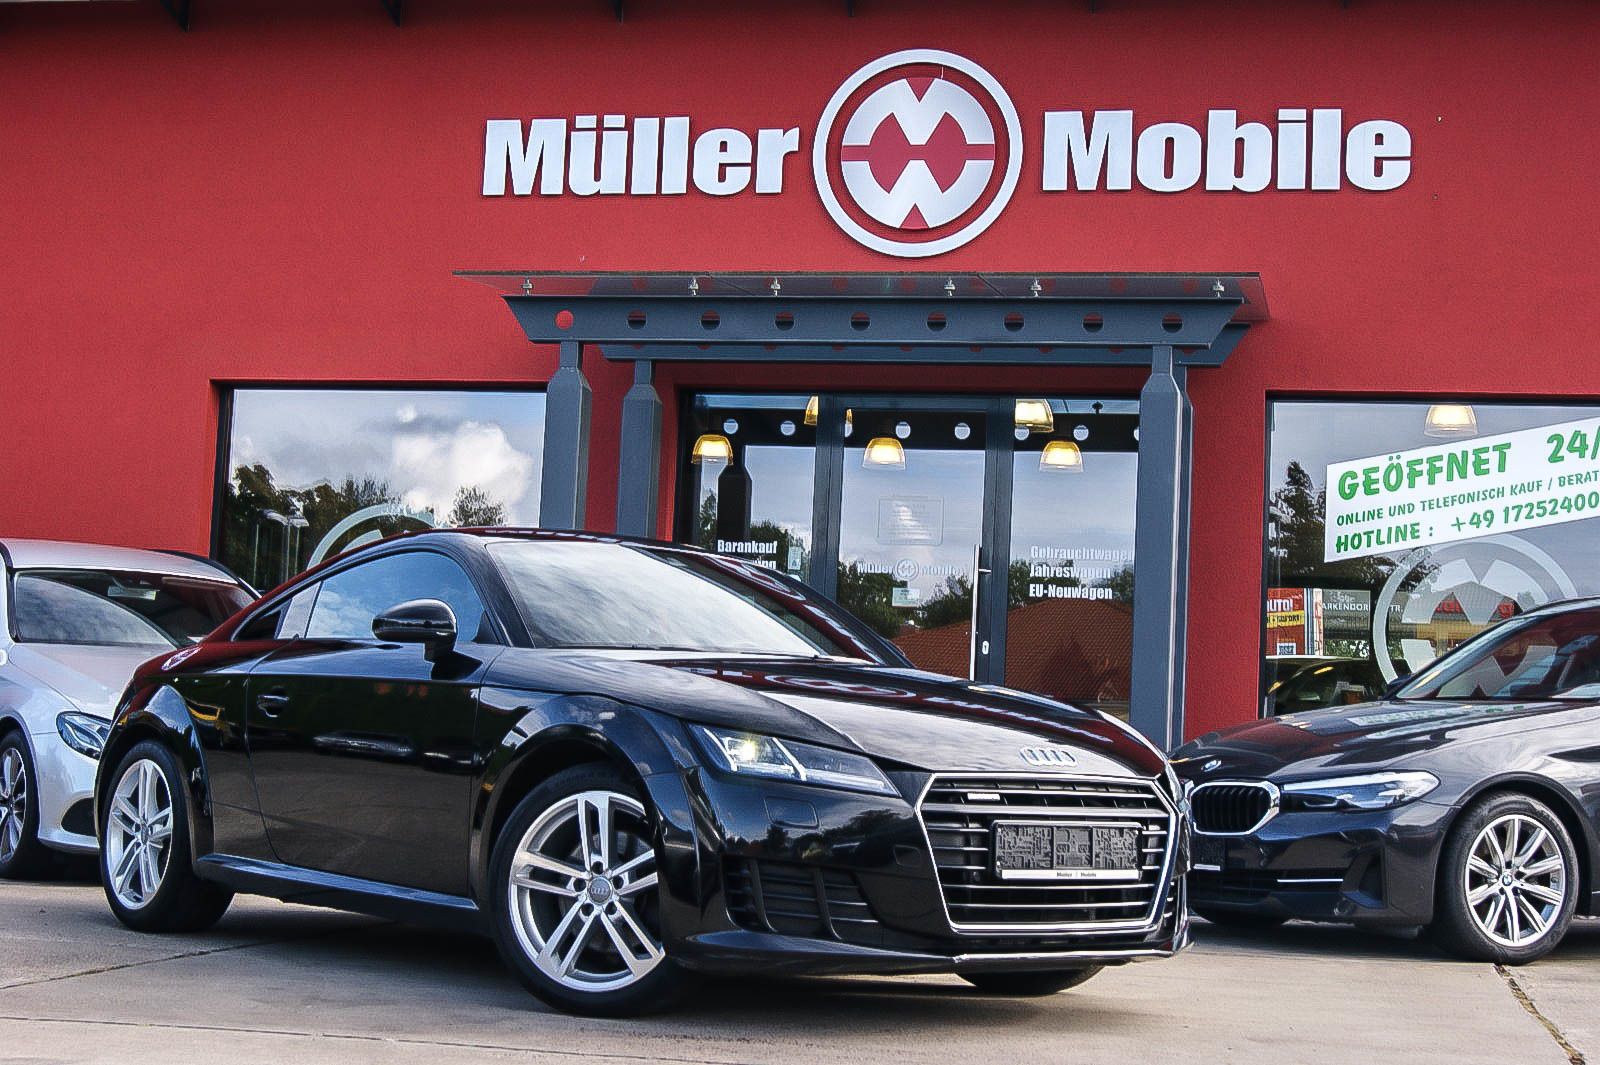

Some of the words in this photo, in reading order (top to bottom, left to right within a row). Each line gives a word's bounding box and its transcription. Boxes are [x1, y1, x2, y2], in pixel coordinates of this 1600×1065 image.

[482, 115, 800, 196] Müller
[1042, 108, 1412, 193] Mobile
[1336, 507, 1384, 527] ONLINE
[1388, 502, 1415, 518] UND
[1419, 487, 1505, 512] TELEFONISCH
[1509, 479, 1543, 496] KAUF
[1558, 470, 1600, 488] BERAT
[1338, 442, 1512, 500] GEÖFFNET
[717, 540, 778, 554] Barankauf
[1335, 522, 1421, 553] HOTLINE
[1450, 509, 1495, 533] +49
[1503, 491, 1600, 525] 17252400
[1029, 583, 1113, 601] EU-Neuwagen
